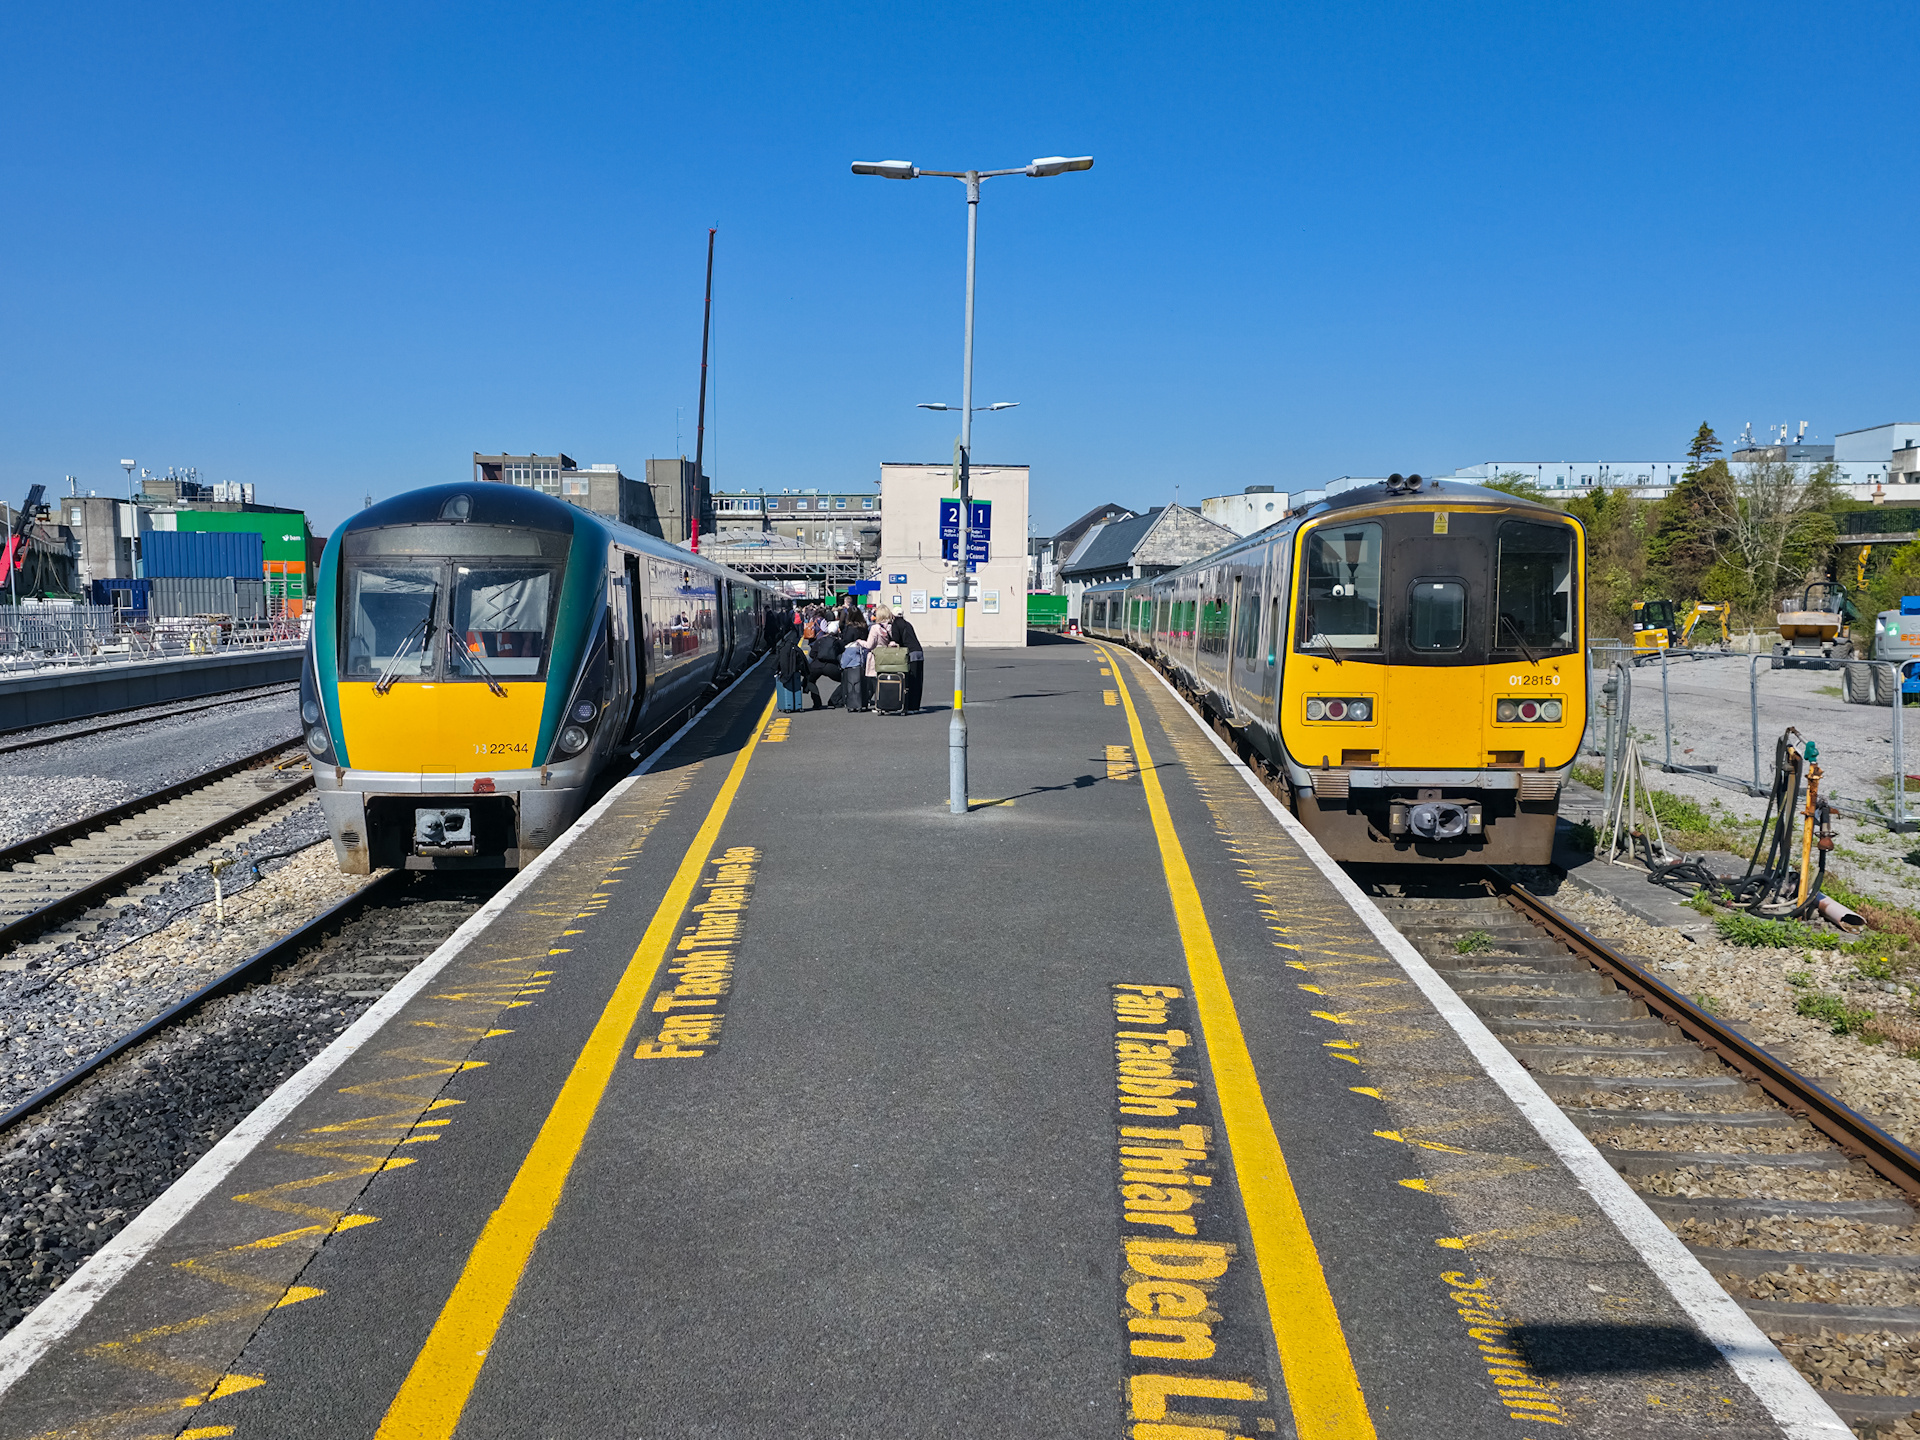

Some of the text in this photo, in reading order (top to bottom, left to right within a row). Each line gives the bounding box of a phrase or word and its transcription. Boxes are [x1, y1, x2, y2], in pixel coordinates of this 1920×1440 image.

[948, 507, 958, 523] 2
[977, 509, 984, 524] 1
[692, 887, 746, 912] Den
[676, 913, 740, 950] Thiar
[652, 950, 733, 1012] Taobh
[1113, 983, 1184, 1025] Fan
[633, 1014, 721, 1059] Fan
[1115, 1029, 1198, 1116] Taobh
[1119, 1124, 1212, 1235] Thiar
[1123, 1239, 1234, 1360] Den
